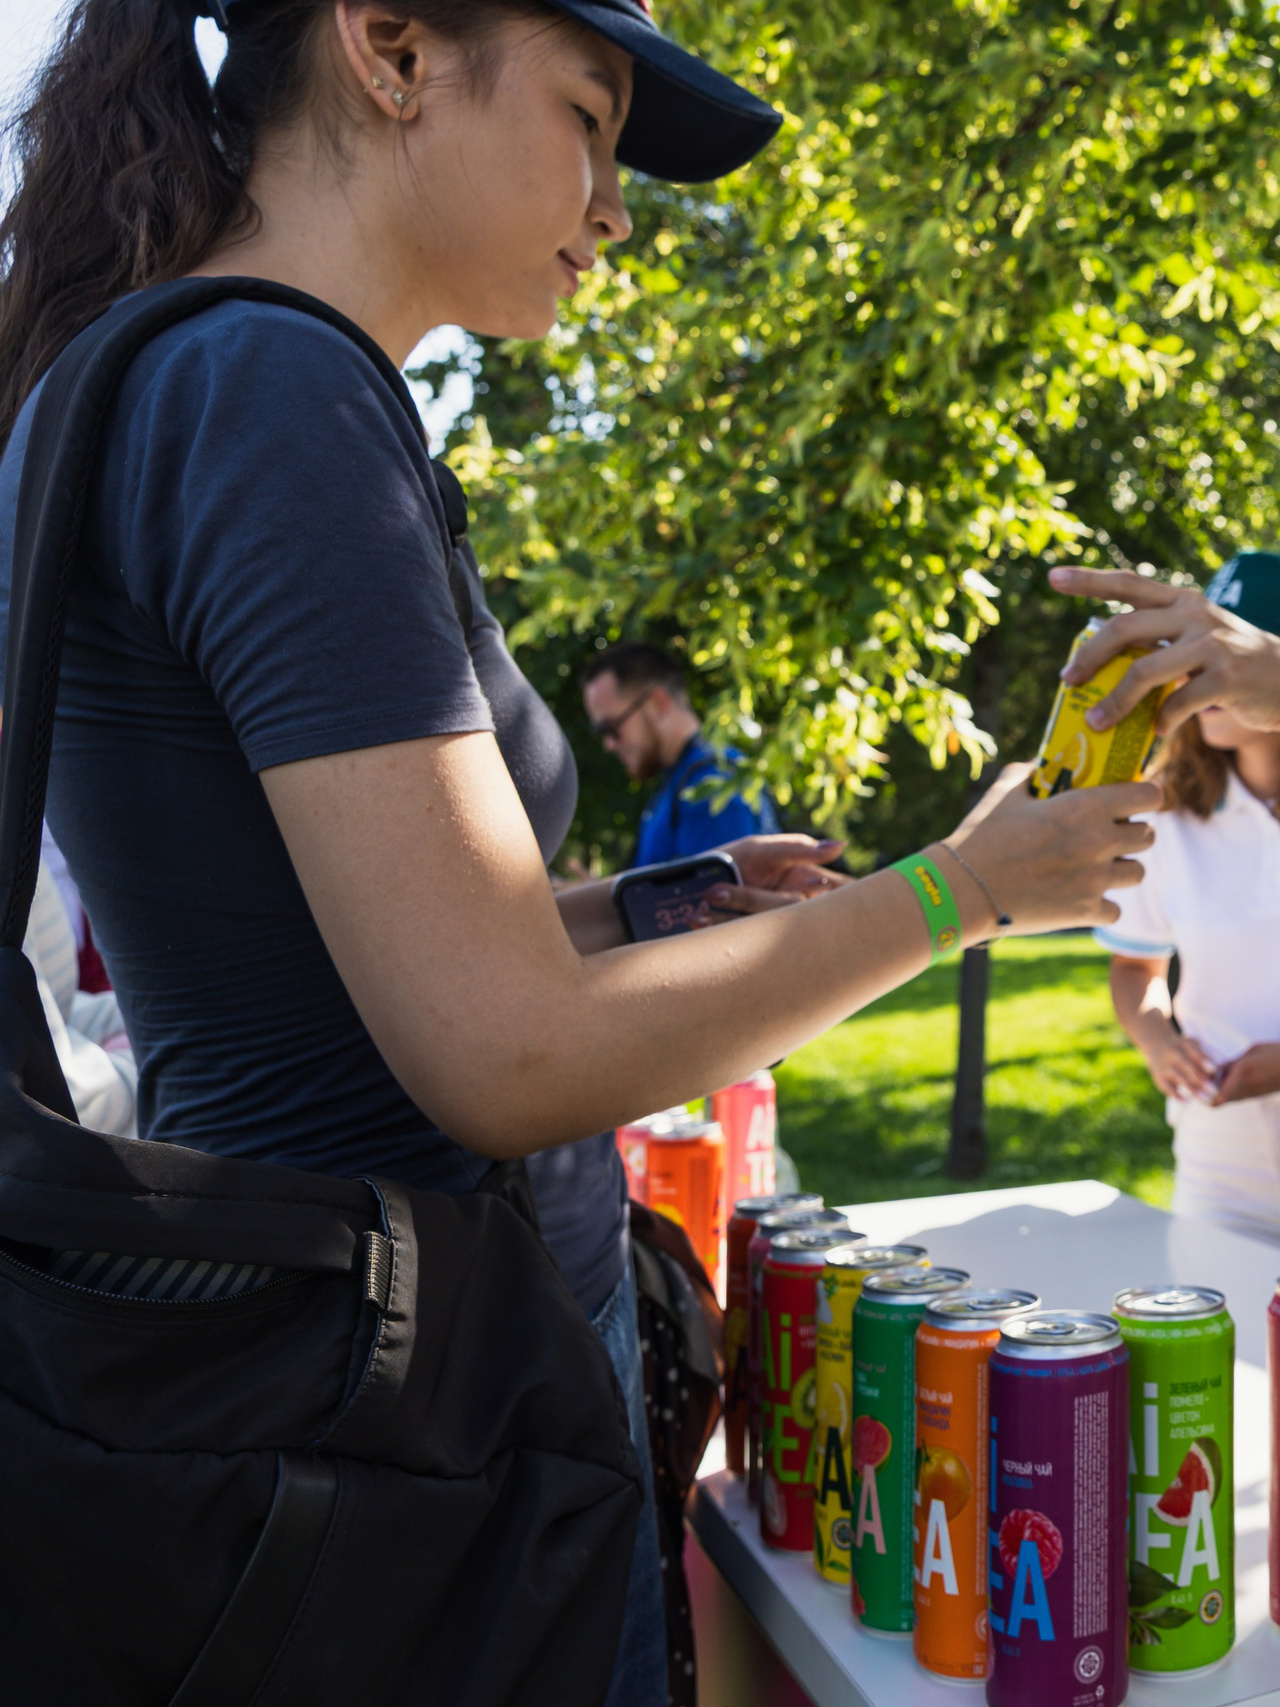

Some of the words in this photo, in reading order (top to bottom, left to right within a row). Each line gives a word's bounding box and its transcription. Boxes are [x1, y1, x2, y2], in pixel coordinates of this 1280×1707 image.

[1169, 1378, 1208, 1395] ЗЕЛЕНЫЙ
[1169, 1393, 1205, 1408] ПОМЕЛО
[1169, 1410, 1201, 1425] ЦВЕТОК
[1169, 1423, 1216, 1440] АПЕЛЬСИНА
[1002, 1459, 1033, 1476] ЧЕРНЫЙ
[1034, 1461, 1053, 1477] ЧАЙ
[988, 1527, 1056, 1642] EA
